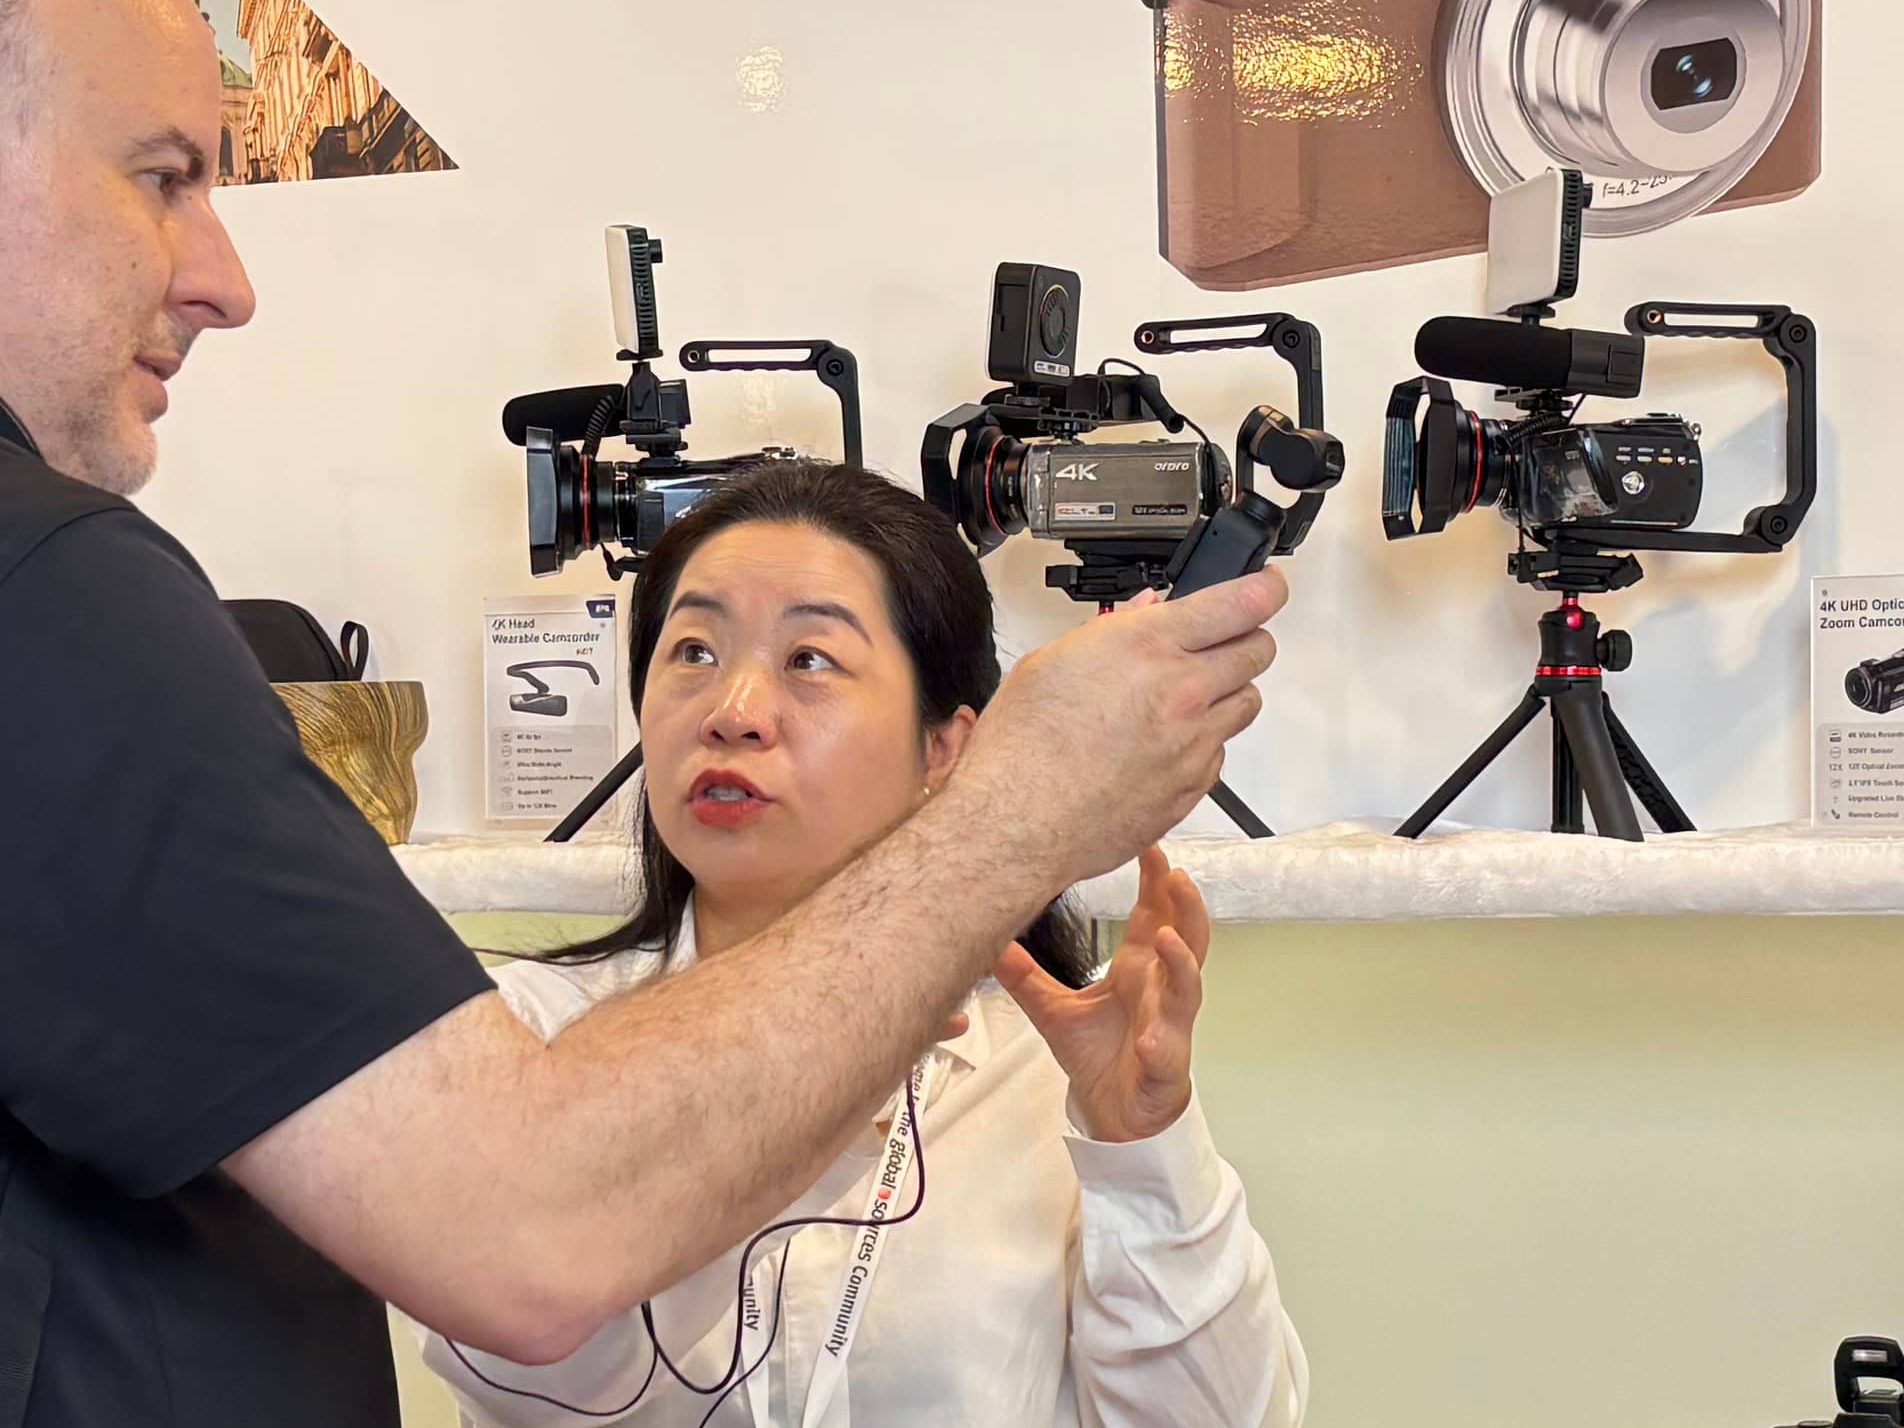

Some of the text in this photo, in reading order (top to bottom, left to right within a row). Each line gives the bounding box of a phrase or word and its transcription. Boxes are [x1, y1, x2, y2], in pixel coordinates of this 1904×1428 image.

[1055, 462, 1102, 481] 4K
[1819, 600, 1837, 612] 4K
[1840, 598, 1868, 612] UHD
[1819, 617, 1855, 630] Zoom
[825, 1138, 906, 1358] global sorces Community
